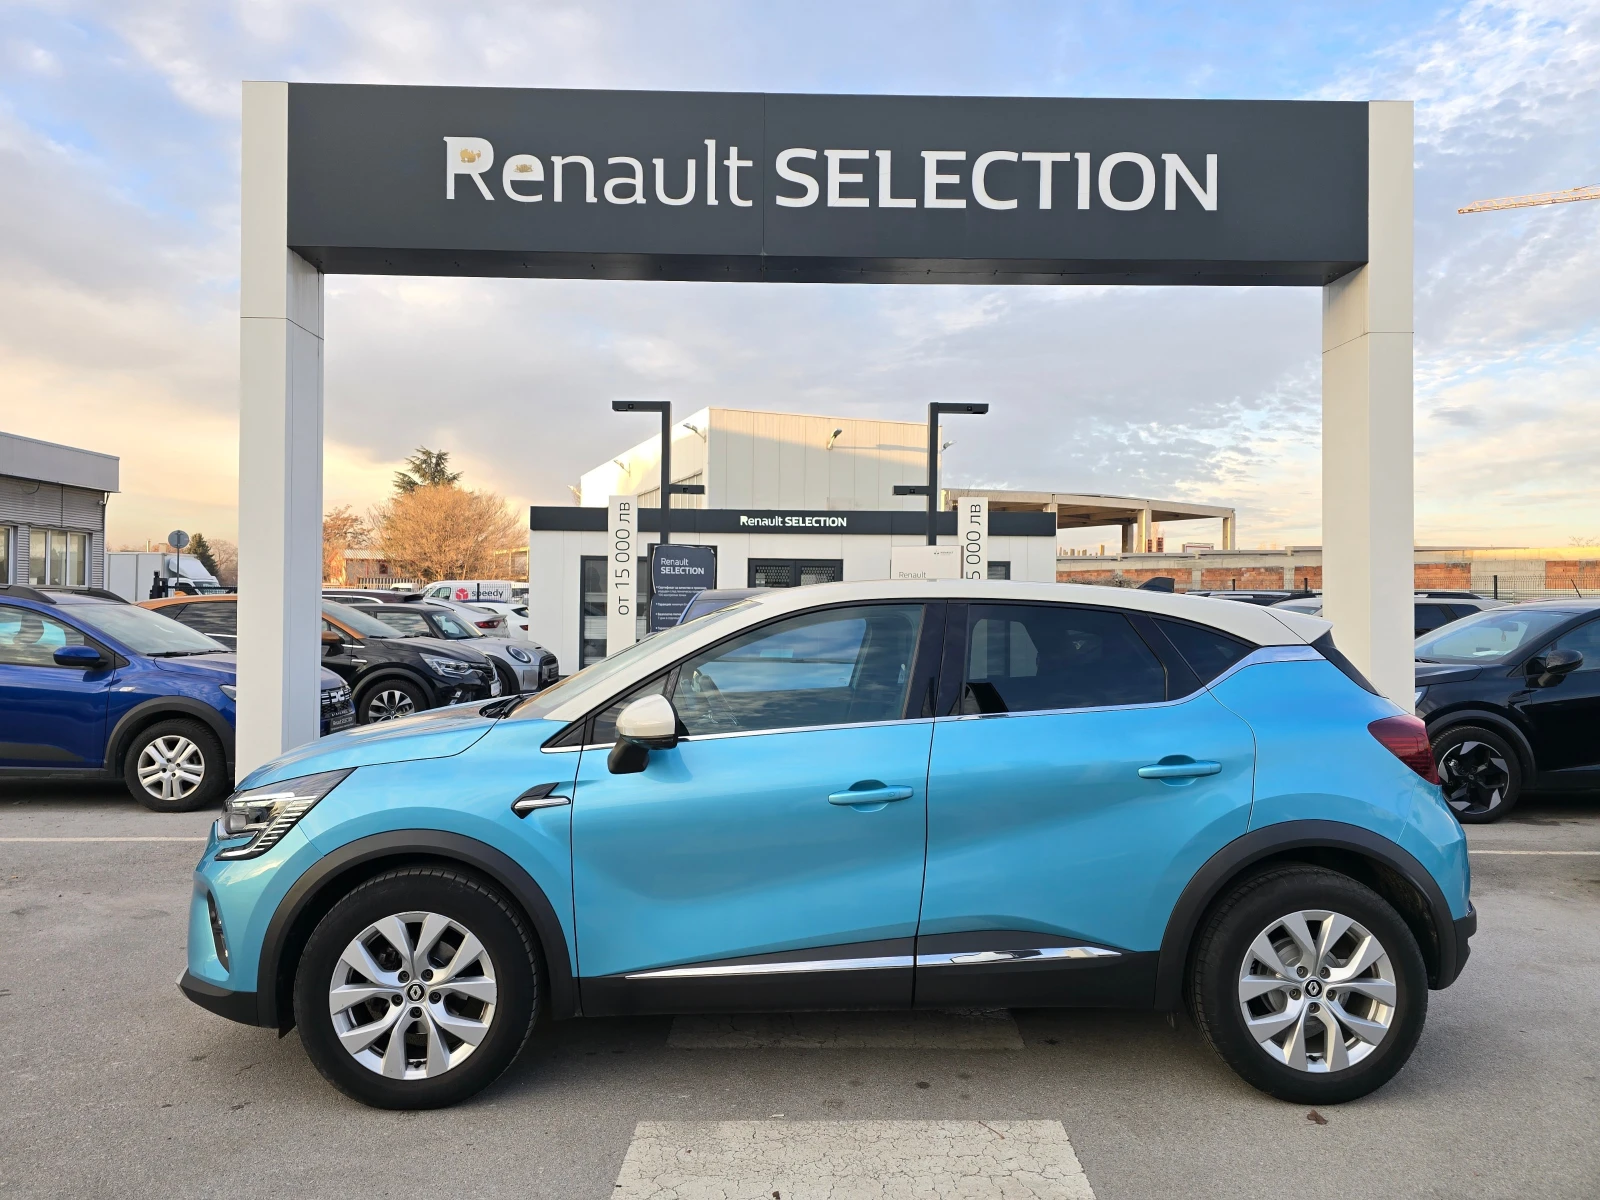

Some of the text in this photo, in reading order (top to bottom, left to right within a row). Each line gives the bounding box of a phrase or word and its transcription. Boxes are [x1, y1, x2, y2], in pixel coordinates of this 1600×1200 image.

[443, 136, 1218, 211] Renault SELECTION
[740, 516, 847, 527] Renault SELECTION
[970, 504, 981, 526] лв
[966, 531, 981, 565] 000
[615, 502, 631, 615] от 15 000 лв
[660, 557, 689, 566] Renault
[660, 566, 705, 575] SELECTION
[898, 571, 927, 579] Renault
